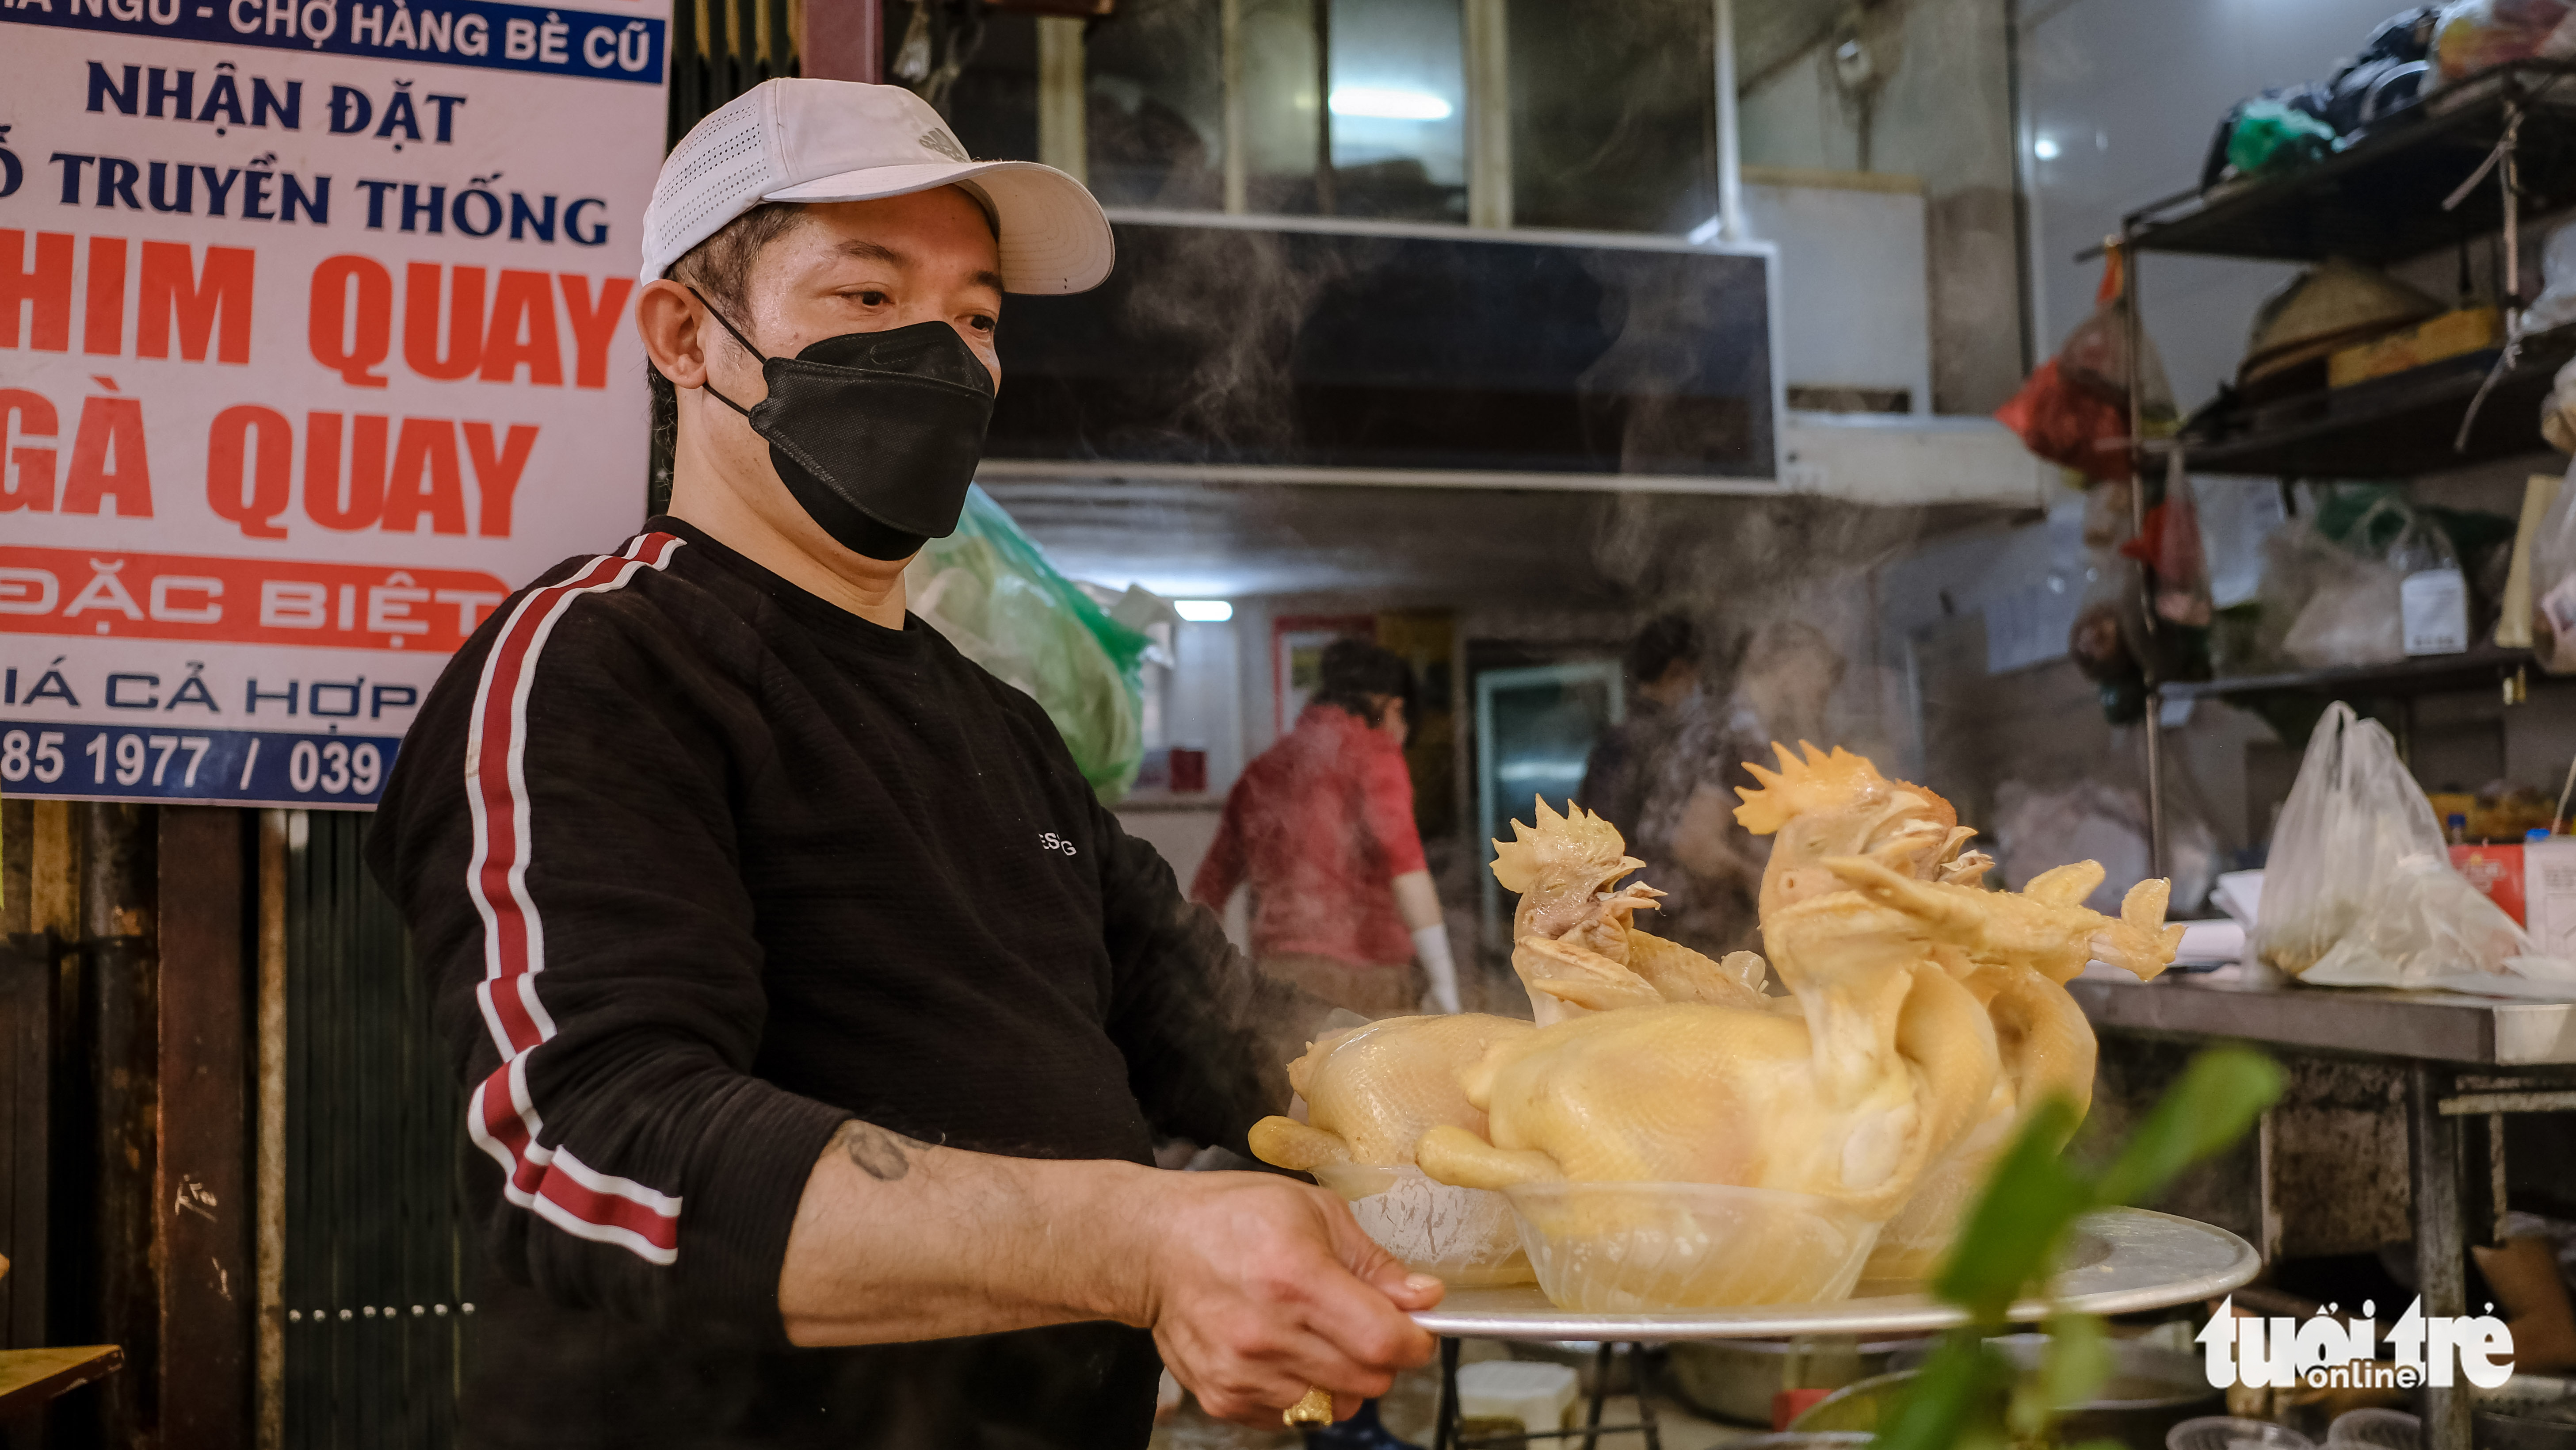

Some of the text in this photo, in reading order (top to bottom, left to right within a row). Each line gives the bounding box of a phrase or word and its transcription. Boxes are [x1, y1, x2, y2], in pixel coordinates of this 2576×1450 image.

[228, 0, 337, 49] CHỢ
[351, 0, 488, 56] HÀNG
[504, 11, 569, 64] BÈ
[583, 21, 650, 72] CŨ
[86, 61, 468, 152] NHẬN ĐẶT
[355, 173, 610, 247] THỐNG
[0, 228, 634, 390] HIM QUAY
[0, 375, 539, 540] GÀ QUAY
[0, 559, 504, 647] ĐẶC BIỆT
[4, 655, 418, 735] IÁ CẢ HỢP
[1, 729, 382, 795] 85 1977 / 039
